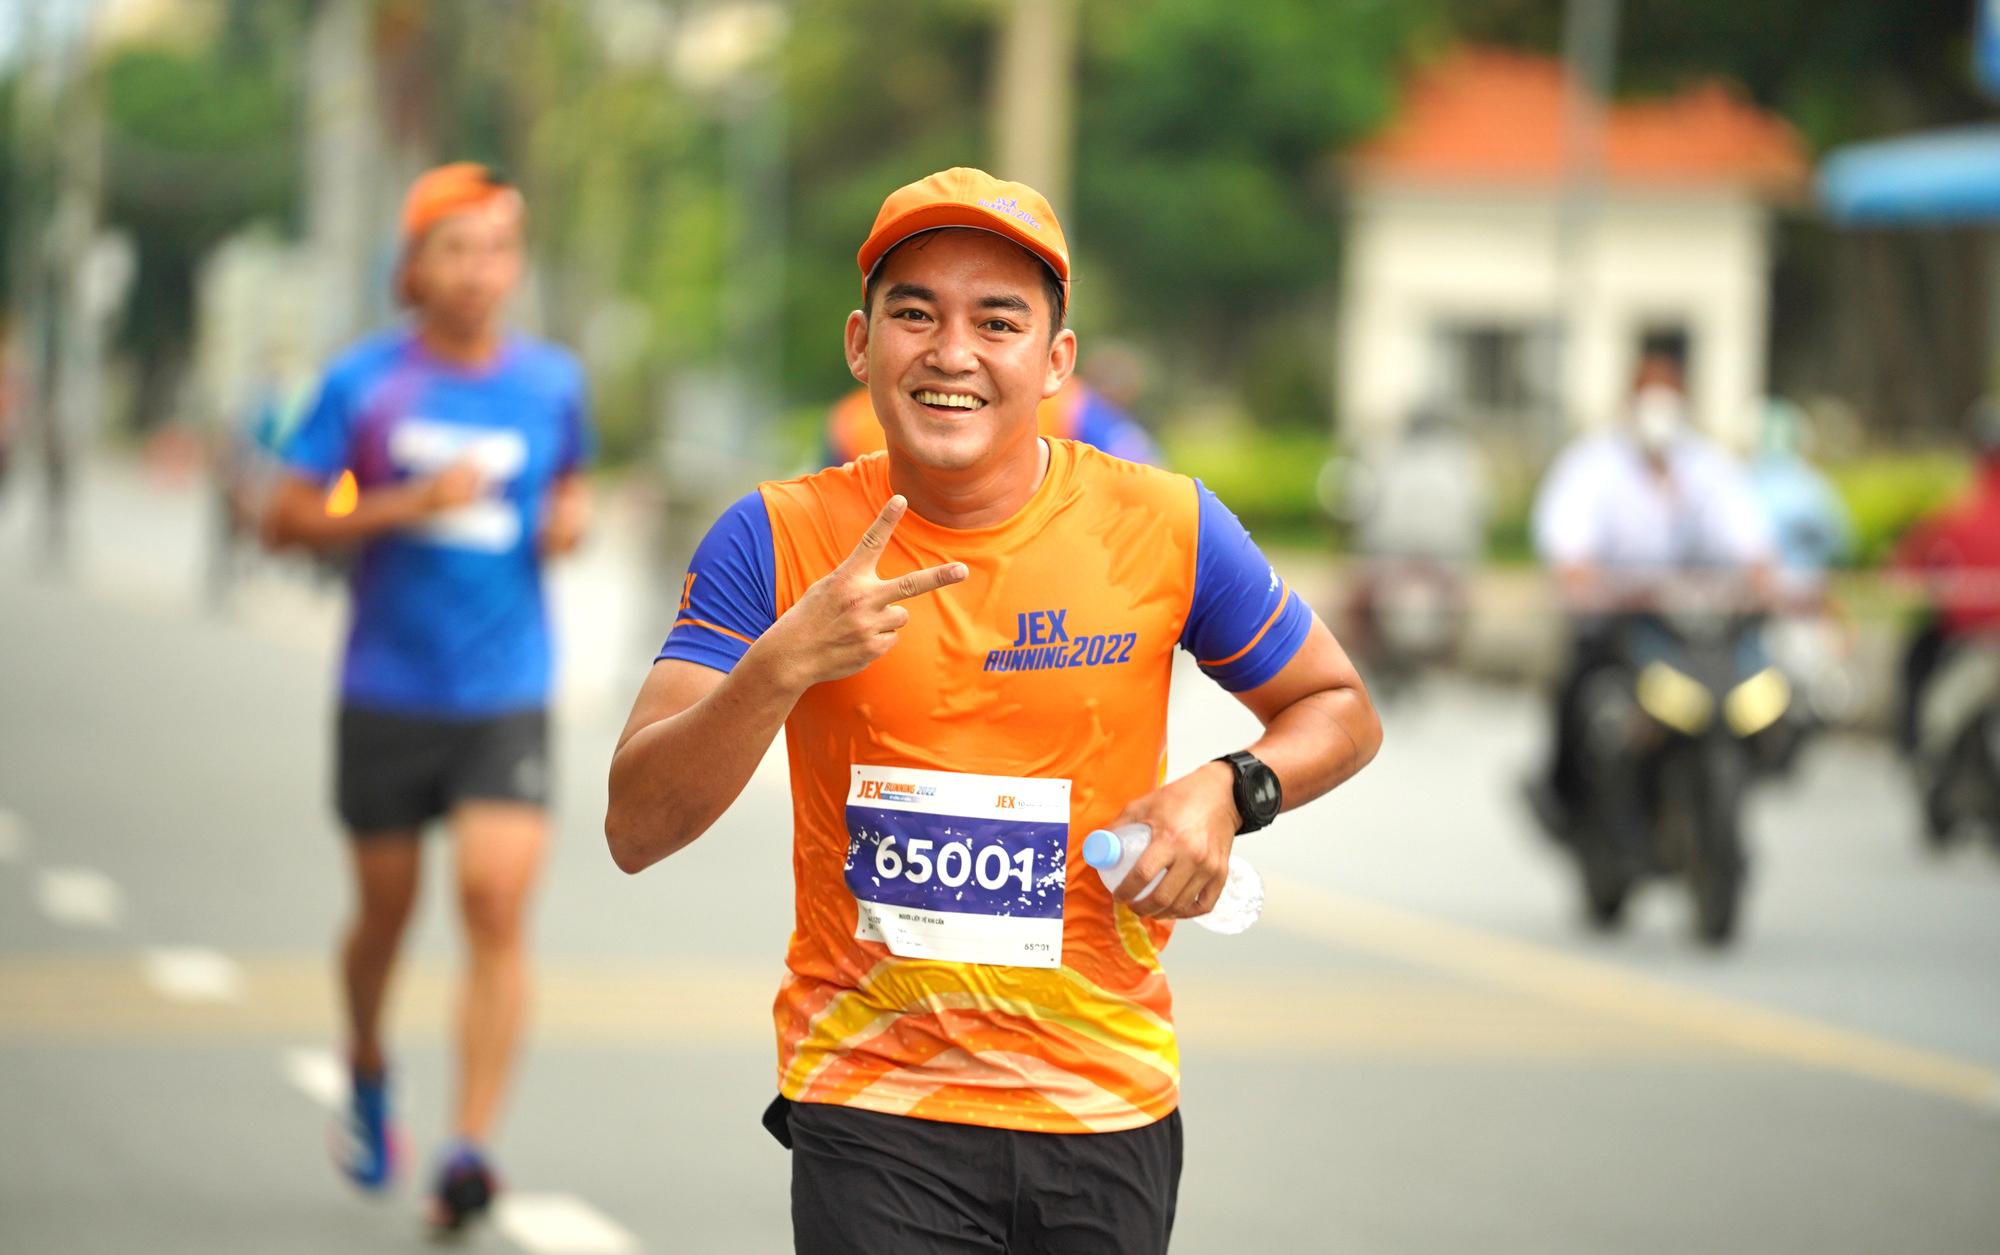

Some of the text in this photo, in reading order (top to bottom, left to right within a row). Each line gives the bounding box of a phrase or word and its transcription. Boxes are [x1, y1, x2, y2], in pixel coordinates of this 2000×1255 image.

[1013, 608, 1069, 647] JEX
[983, 632, 1137, 672] RUNNING 2022
[857, 780, 884, 800] JEX
[884, 782, 916, 794] RUNNING
[995, 795, 1016, 809] JEX
[875, 835, 1035, 892] 65001
